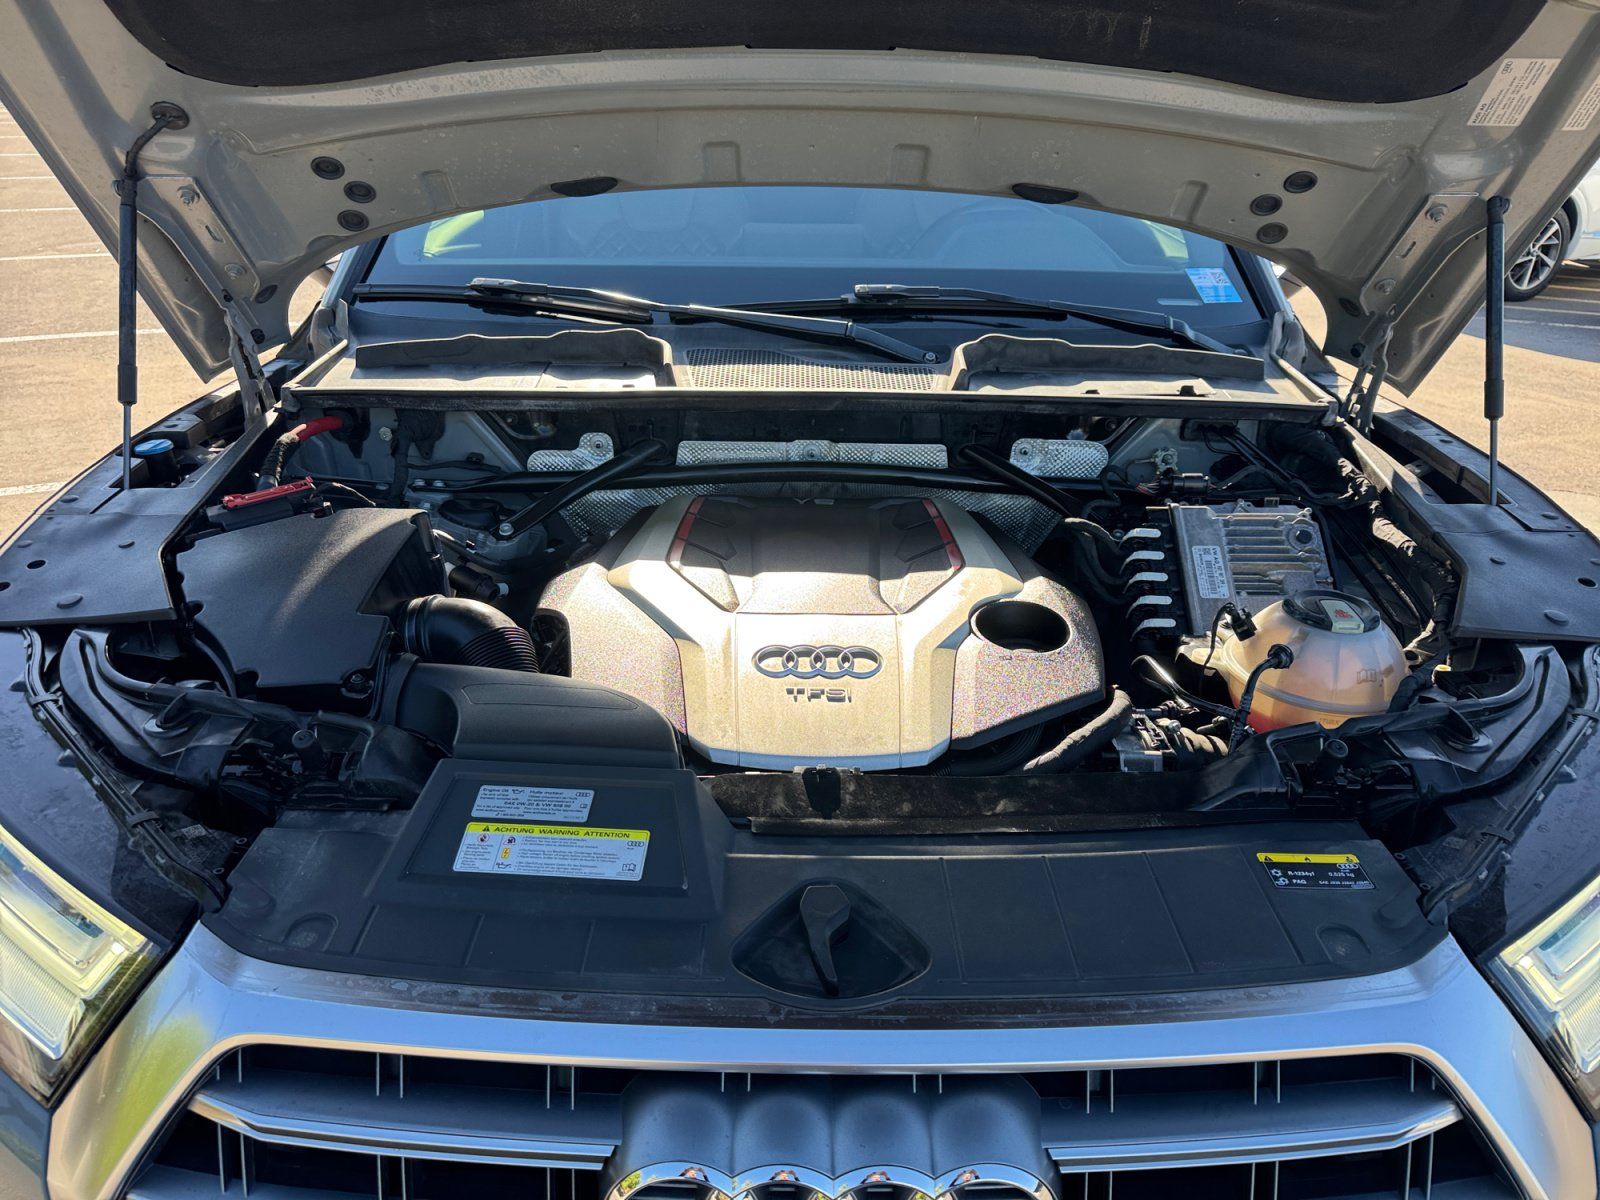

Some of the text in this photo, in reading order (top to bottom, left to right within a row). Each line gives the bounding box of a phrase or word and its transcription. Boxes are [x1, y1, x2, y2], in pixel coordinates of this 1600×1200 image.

[785, 687, 852, 703] TFSI
[494, 826, 535, 834] ACHTUNG
[539, 829, 580, 837] WARNING
[583, 831, 631, 839] ATTENTION
